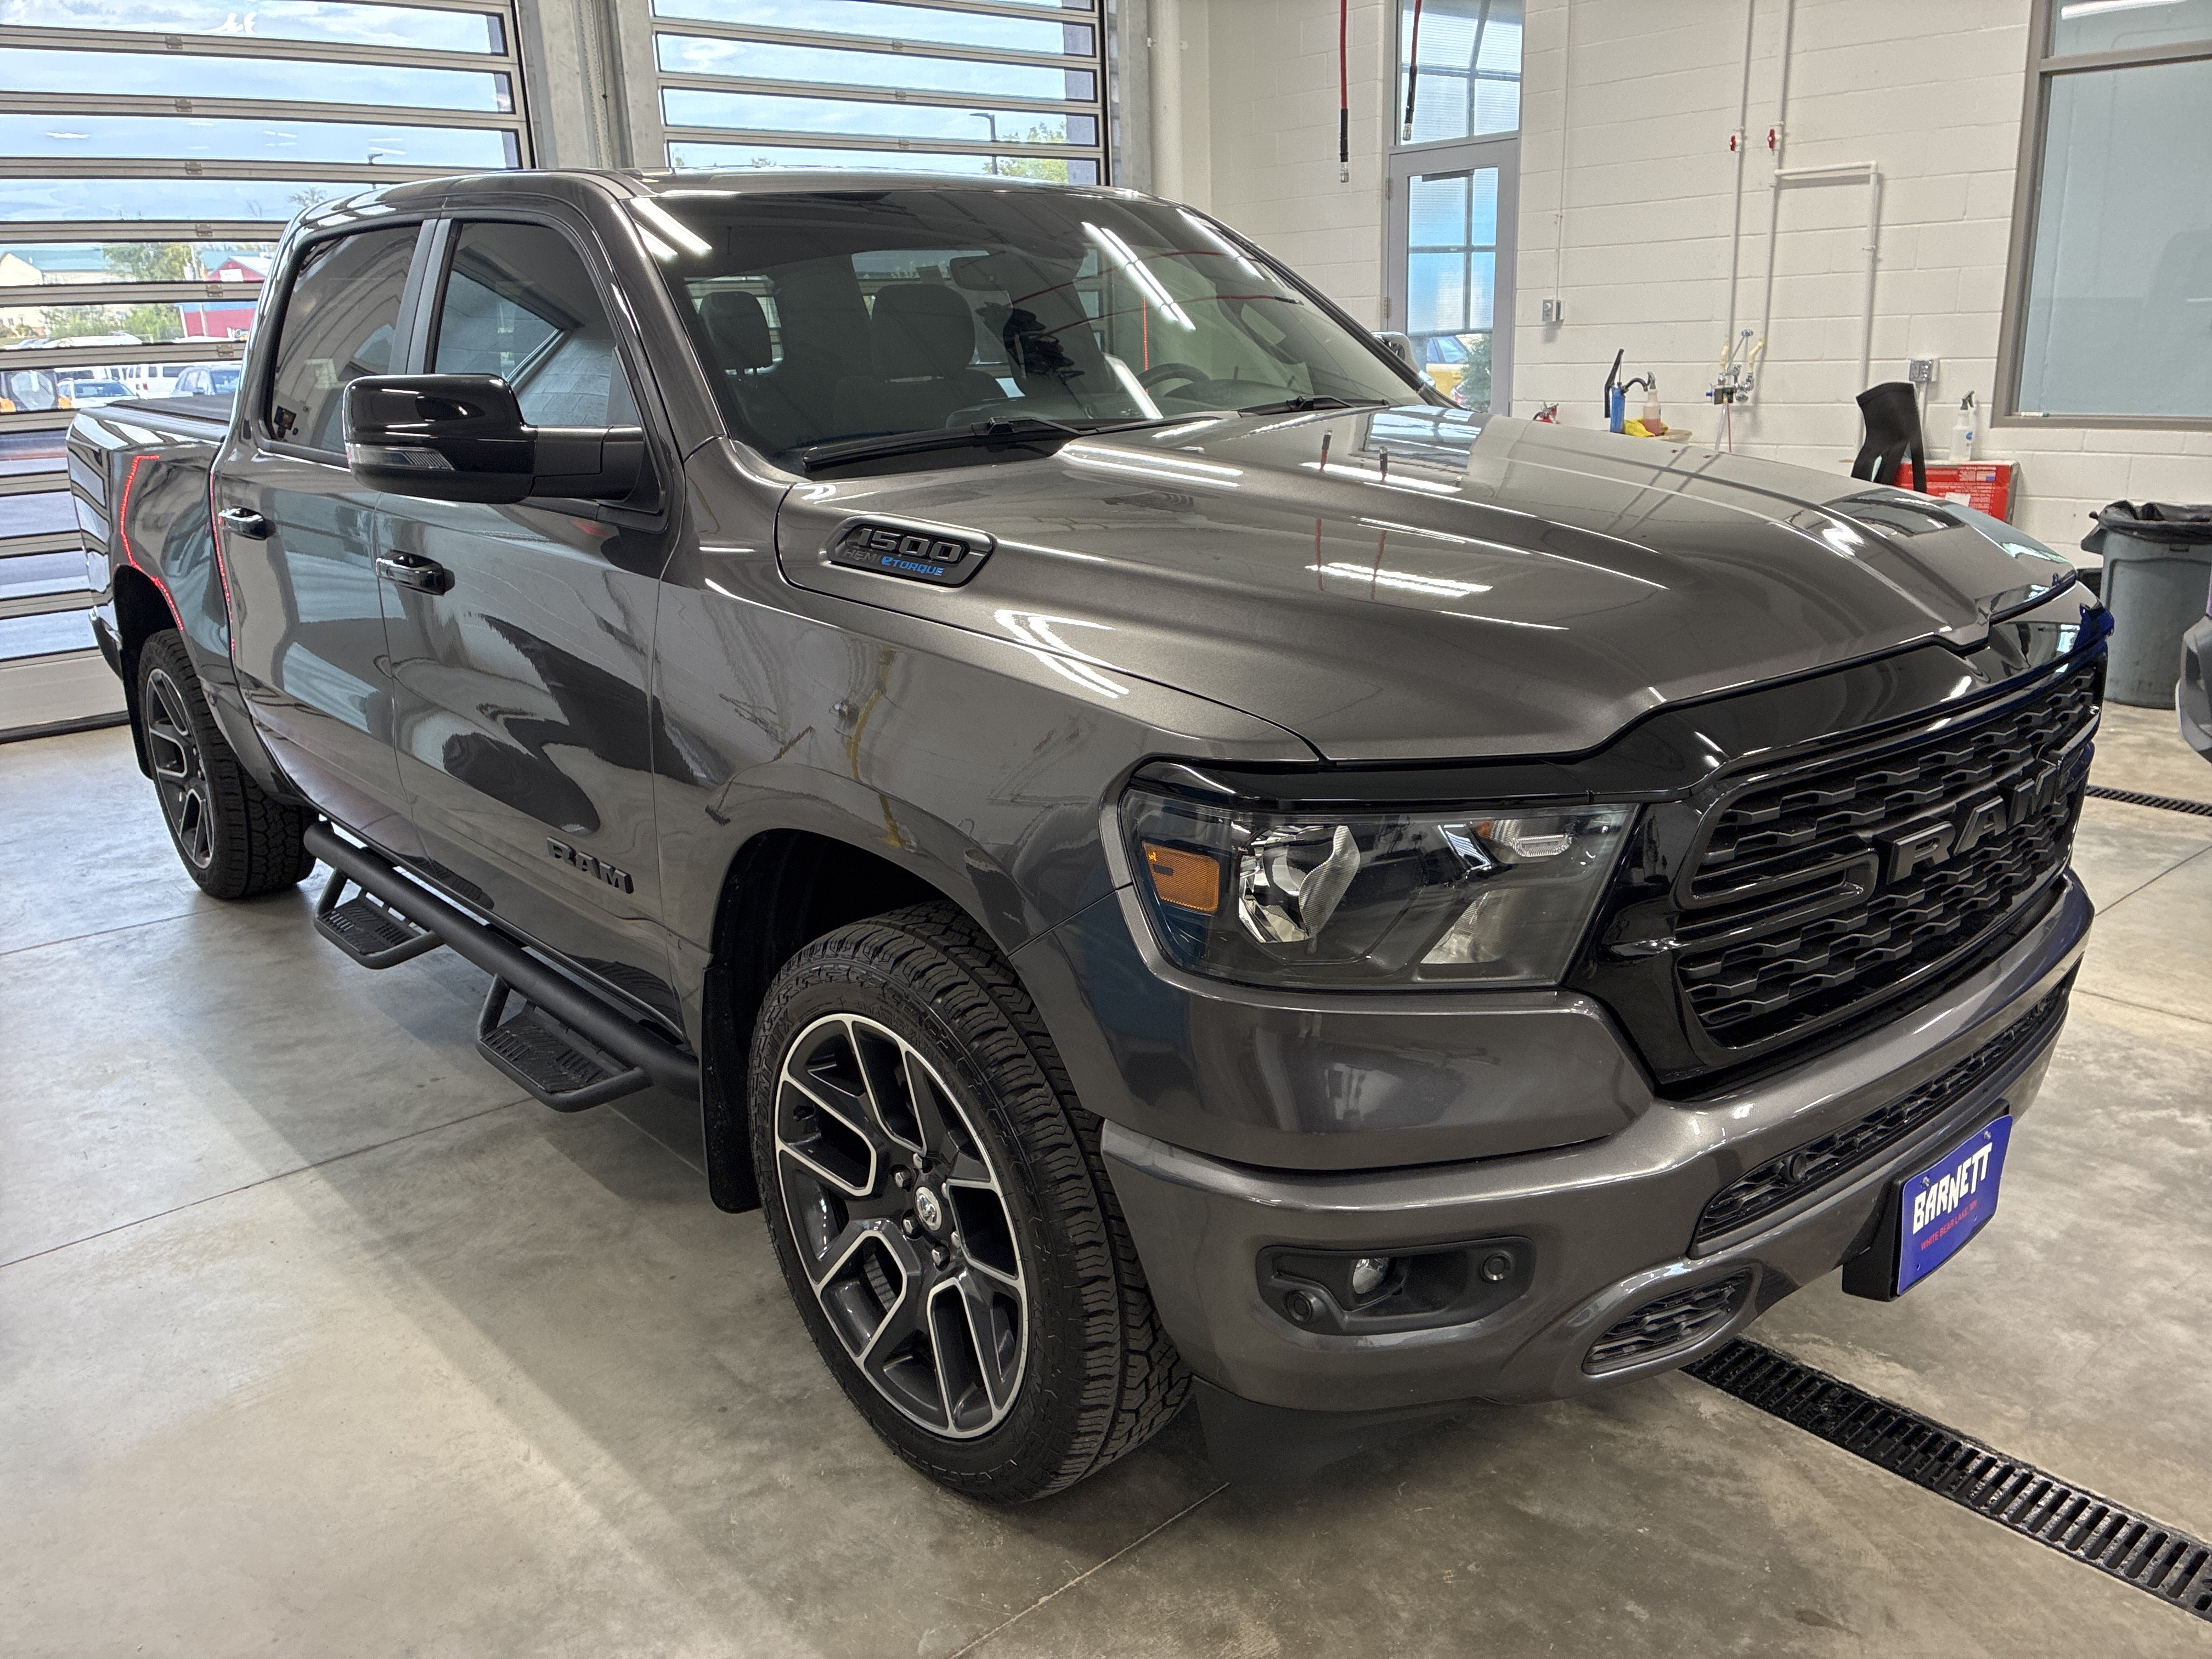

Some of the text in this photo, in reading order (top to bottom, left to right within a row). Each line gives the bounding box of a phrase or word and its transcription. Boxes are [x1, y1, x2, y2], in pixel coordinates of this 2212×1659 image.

[847, 527, 964, 564] 1500
[1886, 765, 2057, 885] RAM
[547, 836, 634, 894] RAM
[1912, 1142, 1993, 1235] BARNETT
